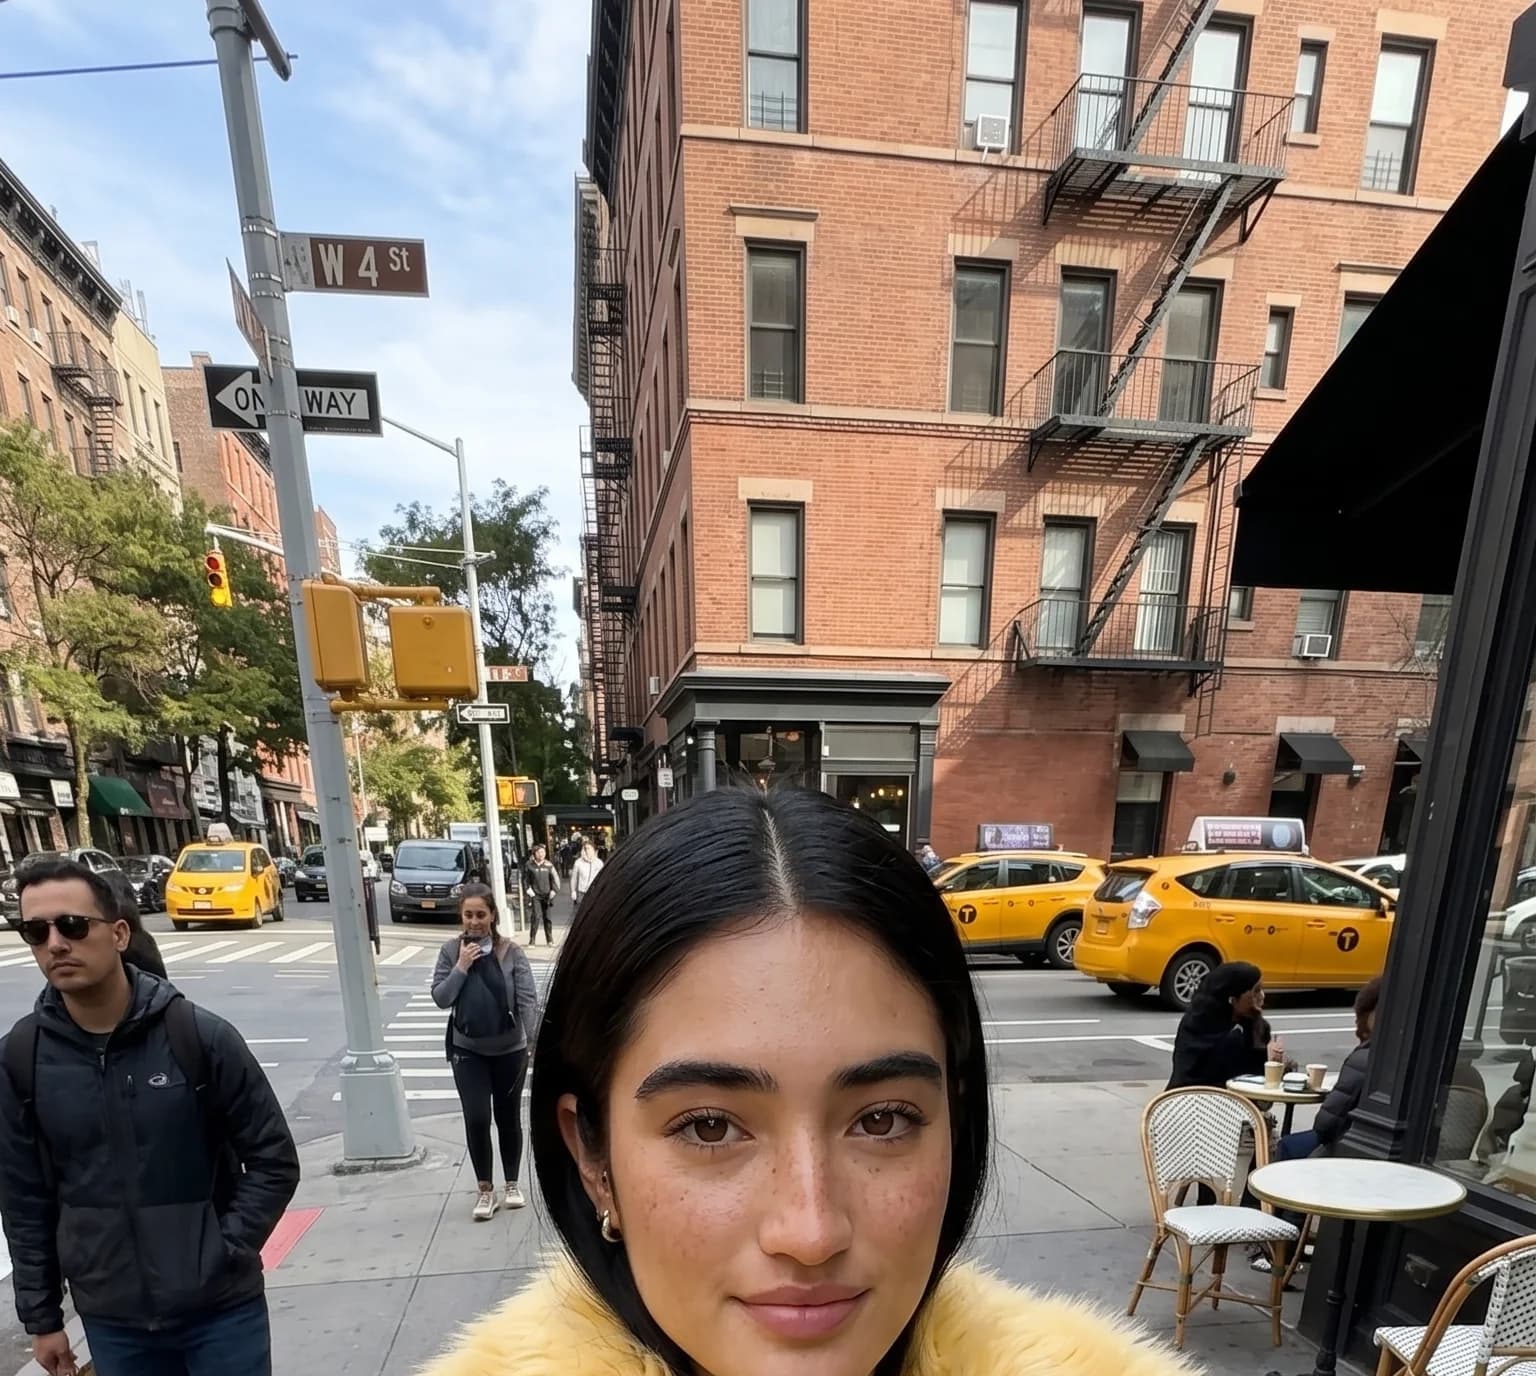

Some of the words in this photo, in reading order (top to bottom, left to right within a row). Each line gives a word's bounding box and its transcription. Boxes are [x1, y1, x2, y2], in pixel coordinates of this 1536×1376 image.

[318, 243, 344, 286] W
[357, 245, 379, 288] 4
[388, 246, 411, 272] St
[234, 386, 265, 411] ON
[304, 389, 357, 416] WAY
